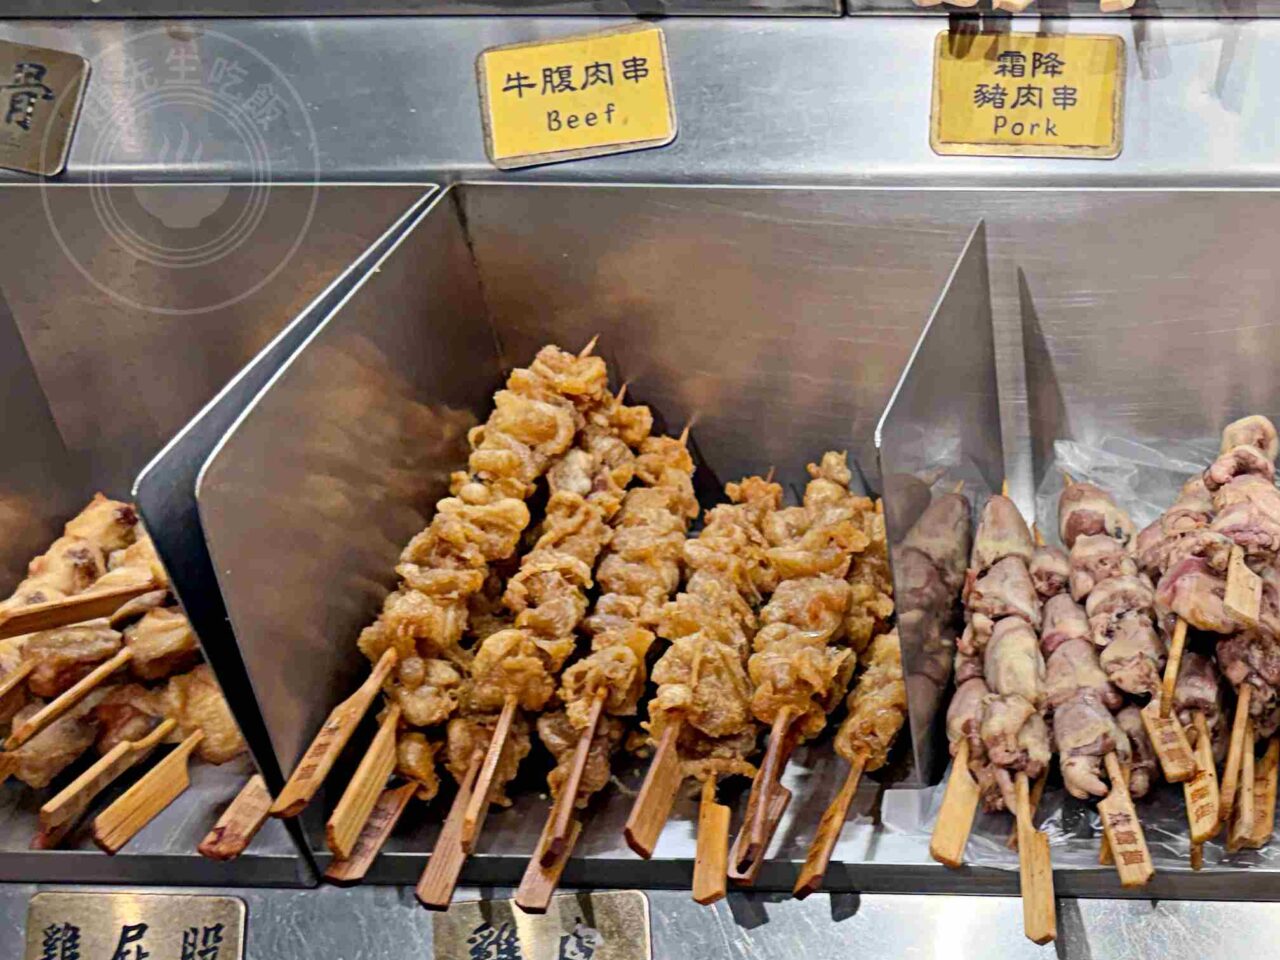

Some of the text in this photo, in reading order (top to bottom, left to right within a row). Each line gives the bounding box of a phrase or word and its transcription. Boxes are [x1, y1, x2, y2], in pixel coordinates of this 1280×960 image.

[502, 56, 649, 98] 牛腹肉串
[994, 51, 1066, 78] 霜降
[973, 83, 1078, 110] 豬肉串
[547, 103, 616, 131] Beef
[993, 115, 1059, 136] Pork
